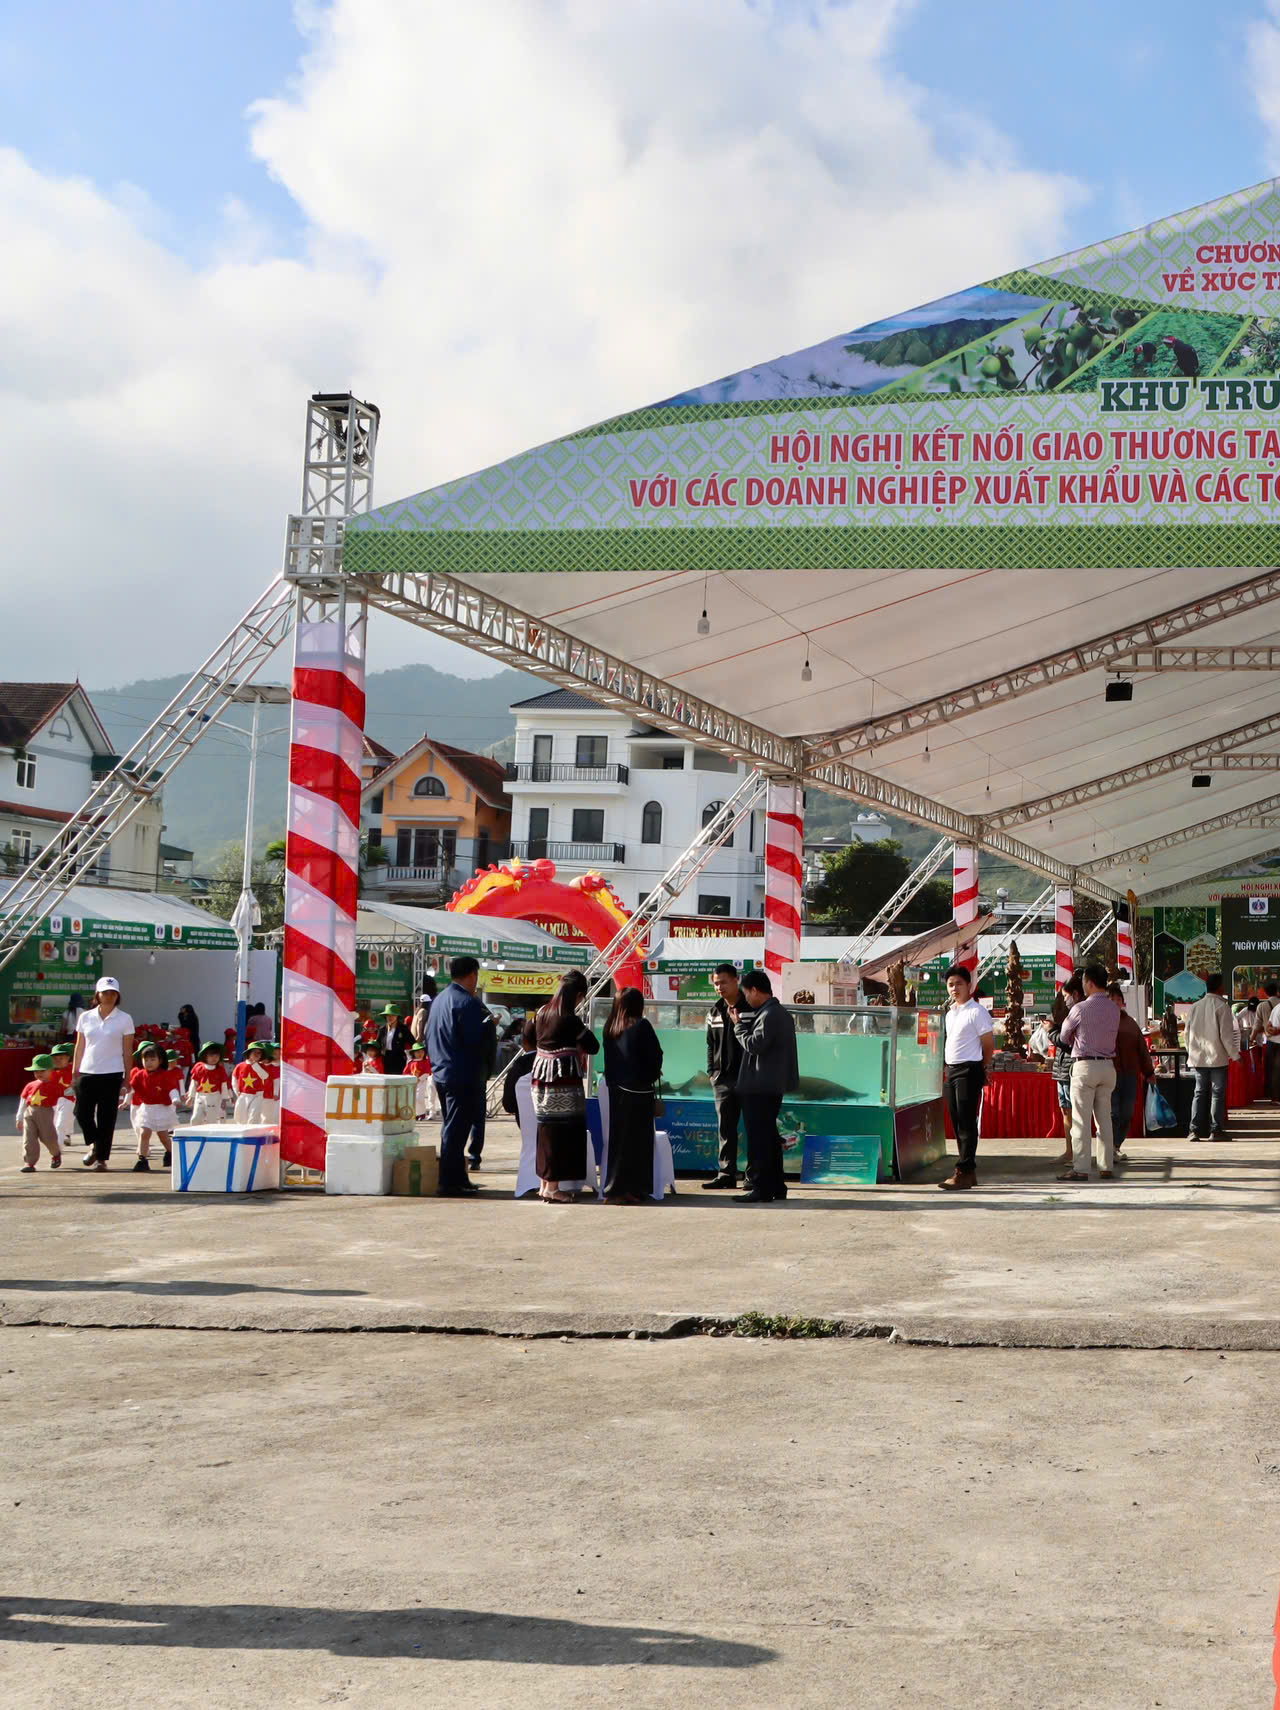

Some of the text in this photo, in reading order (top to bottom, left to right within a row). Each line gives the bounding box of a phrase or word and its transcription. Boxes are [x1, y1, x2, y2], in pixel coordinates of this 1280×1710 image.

[1162, 268, 1195, 293] VỀ
[1201, 268, 1257, 291] XÚC
[1102, 381, 1188, 412] KHU
[771, 430, 820, 470] HỘI
[831, 432, 902, 469] NGHỊ
[912, 424, 965, 461] KẾT
[973, 425, 1023, 461] NỐI
[1032, 431, 1103, 461] GIAO
[1111, 430, 1236, 460] THƯƠNG
[630, 474, 677, 507] VỚI
[686, 472, 738, 506] CÁC
[746, 477, 846, 506] DOANH
[857, 471, 967, 512] NGHIỆP
[975, 466, 1052, 505] XUẤT
[1060, 465, 1141, 504] KHẨU
[1149, 468, 1187, 503] VÀ
[1196, 467, 1251, 503] CÁC
[550, 922, 569, 936] MUA
[1257, 940, 1270, 952] HỘI
[507, 975, 535, 985] KINH
